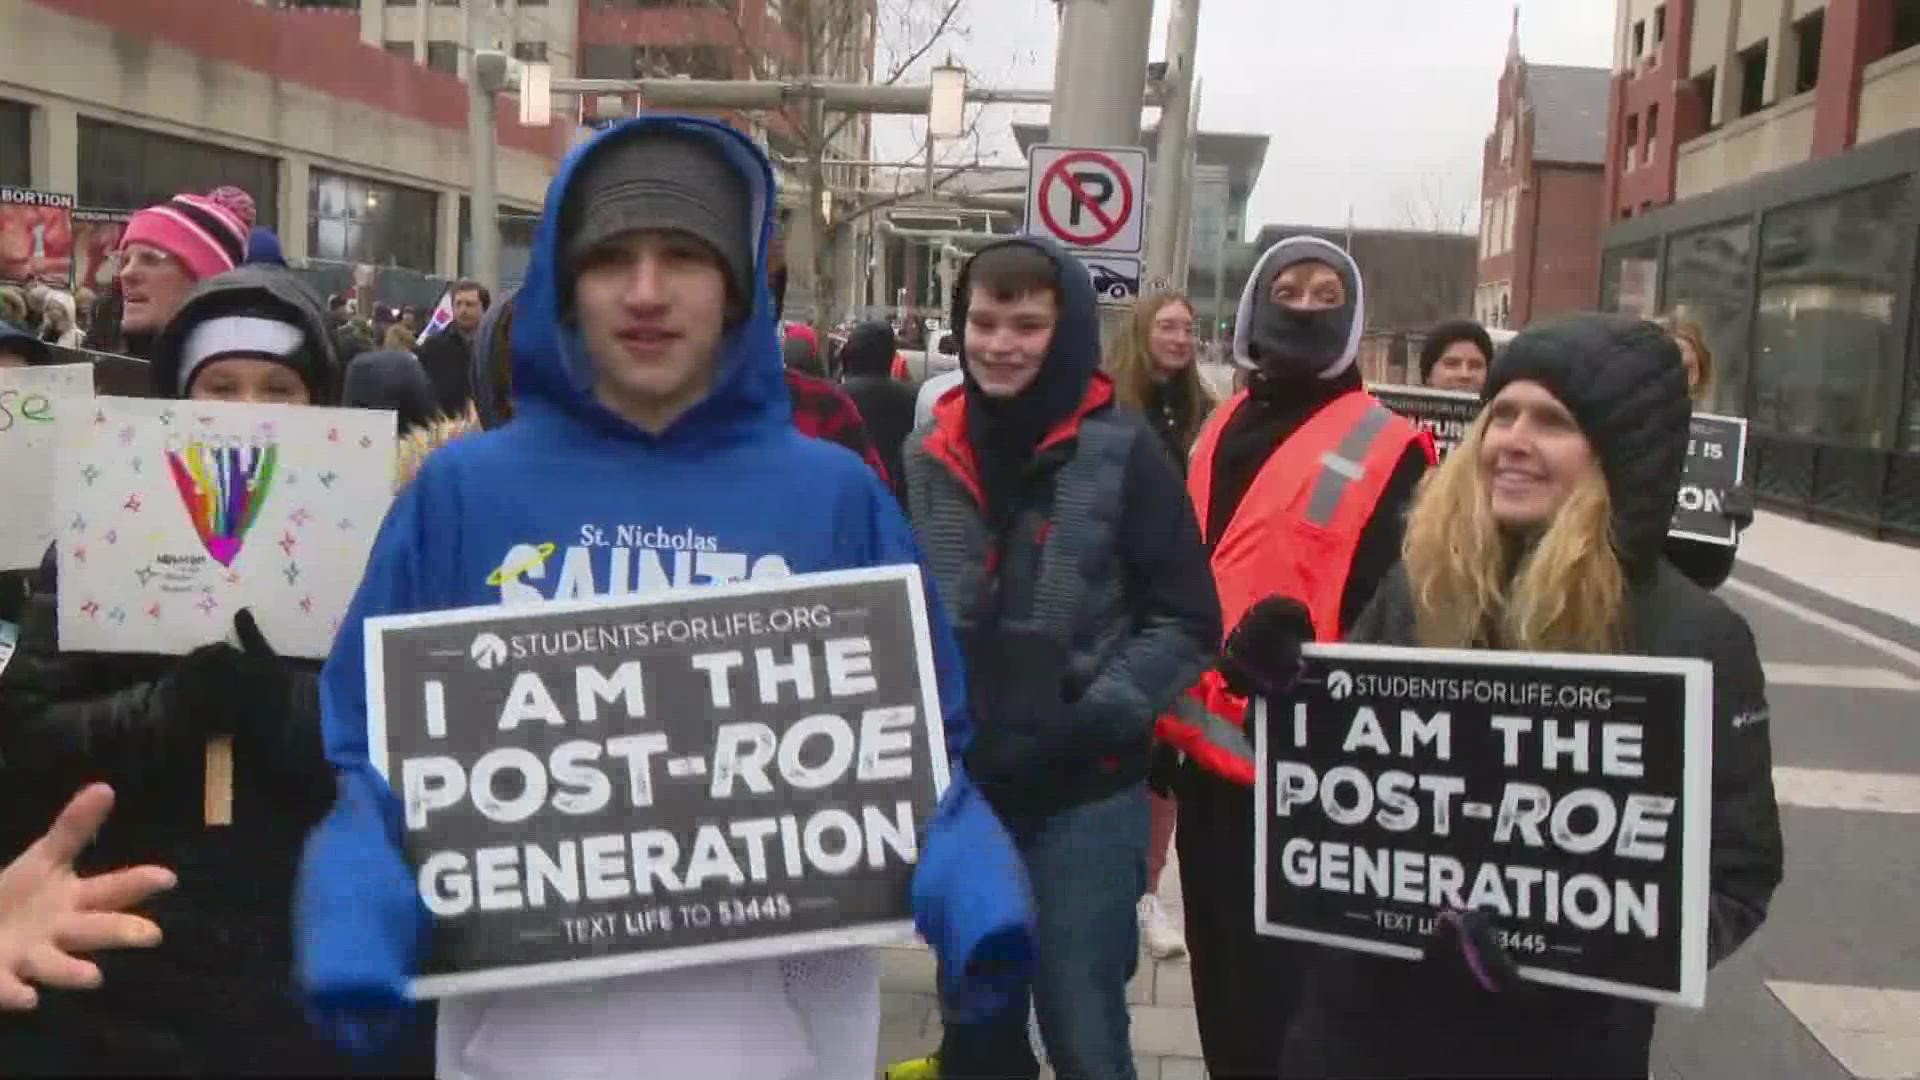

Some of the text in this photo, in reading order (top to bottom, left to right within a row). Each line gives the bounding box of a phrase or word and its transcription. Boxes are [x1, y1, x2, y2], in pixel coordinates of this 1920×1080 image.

[0, 188, 73, 208] BORTION
[1703, 441, 1723, 459] IS
[616, 524, 718, 551] Nicholas
[510, 603, 832, 660] STUDENTSFORLIFE.ORG
[424, 636, 879, 738] I AM THE
[1355, 675, 1612, 711] STUDENTSFORLIFE.ORG
[401, 705, 917, 831] POST-ROE
[1294, 703, 1645, 778] I AM THE
[1275, 761, 1676, 861] POST-ROE
[418, 801, 919, 918] GENERATION
[1281, 837, 1660, 938] GENERATION
[563, 893, 792, 944] TEXT LIFE TO 53445
[1375, 911, 1413, 933] TEXT
[1418, 917, 1441, 936] LI
